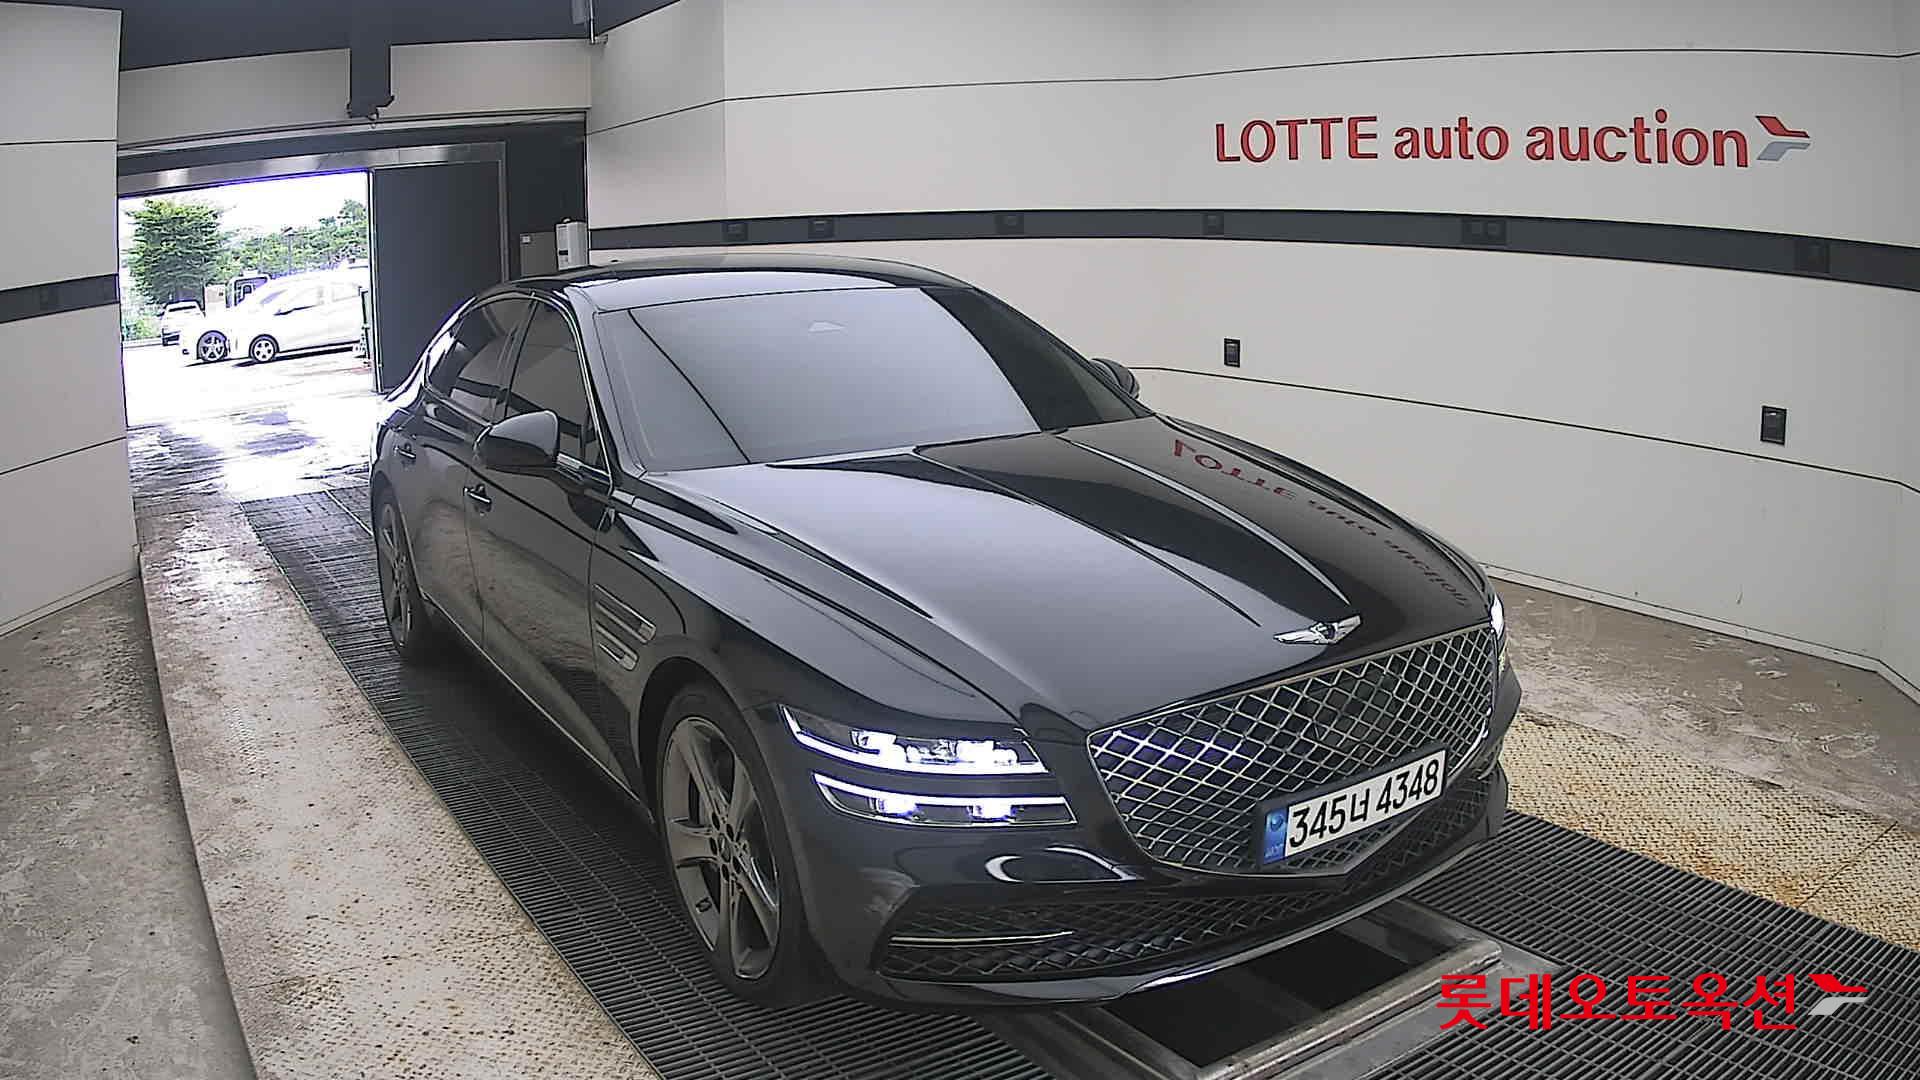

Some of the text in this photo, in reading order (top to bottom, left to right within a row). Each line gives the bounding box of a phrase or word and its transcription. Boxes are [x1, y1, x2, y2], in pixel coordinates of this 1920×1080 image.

[1215, 109, 1750, 168] LOTTE auto auction
[1289, 759, 1440, 848] 345너 4348
